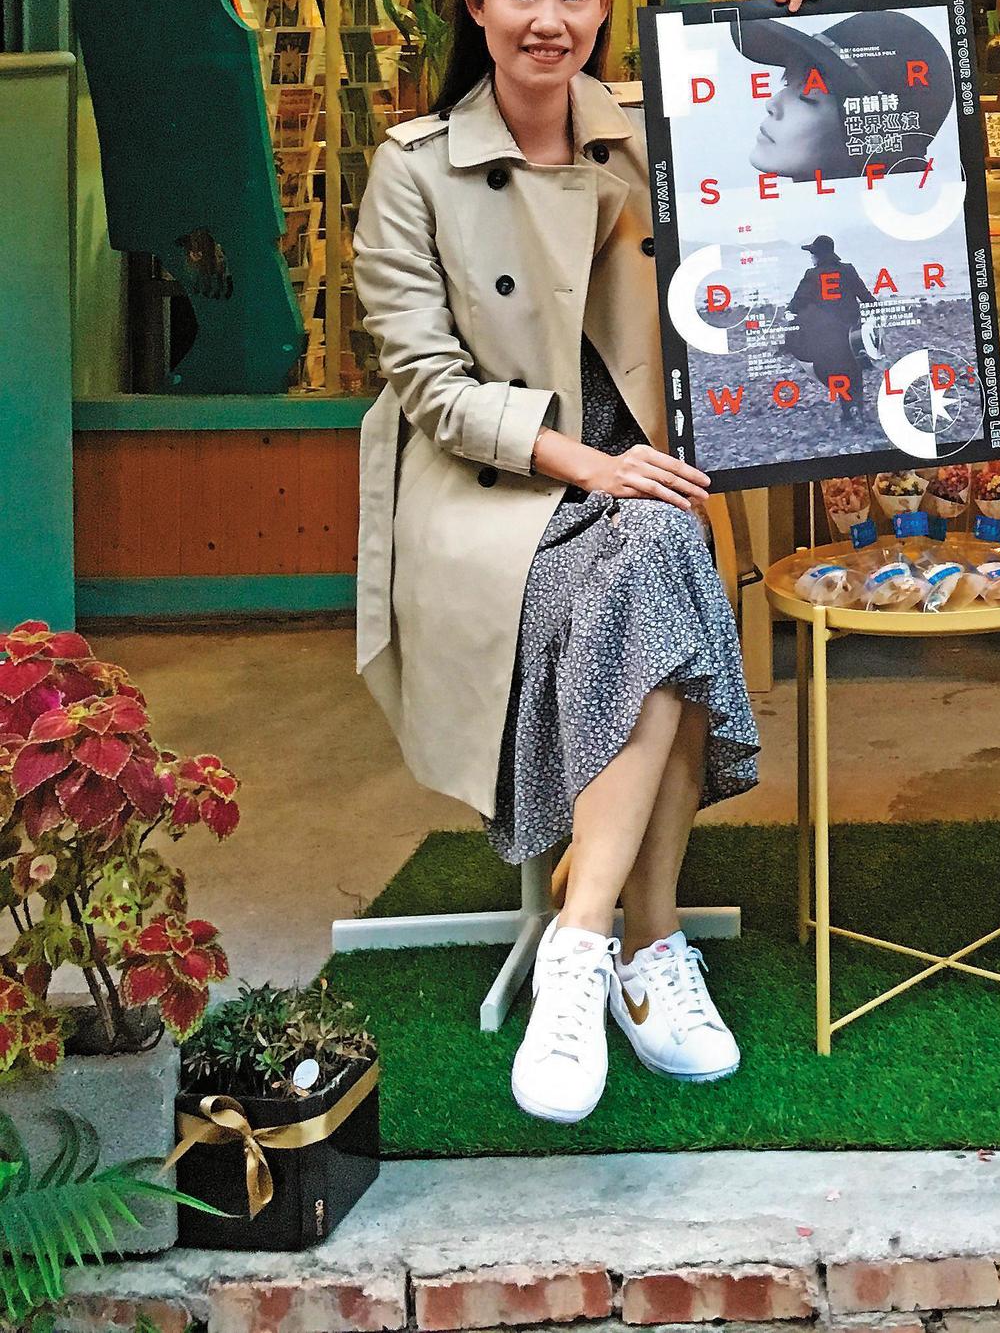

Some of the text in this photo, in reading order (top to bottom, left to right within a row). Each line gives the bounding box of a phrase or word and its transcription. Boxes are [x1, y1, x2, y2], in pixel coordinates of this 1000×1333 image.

[957, 39, 971, 79] TOUR
[691, 59, 930, 104] DEAR
[961, 82, 975, 116] 2018
[843, 93, 899, 115] 何韻詩
[844, 111, 920, 136] 世界巡演
[846, 133, 903, 156] 台灣站
[655, 161, 671, 223] TAIWAN
[707, 263, 948, 313] DEAR
[974, 249, 988, 288] WITH
[978, 292, 993, 341] GDJYB
[983, 344, 994, 354] &
[984, 357, 999, 417] SUBYUB
